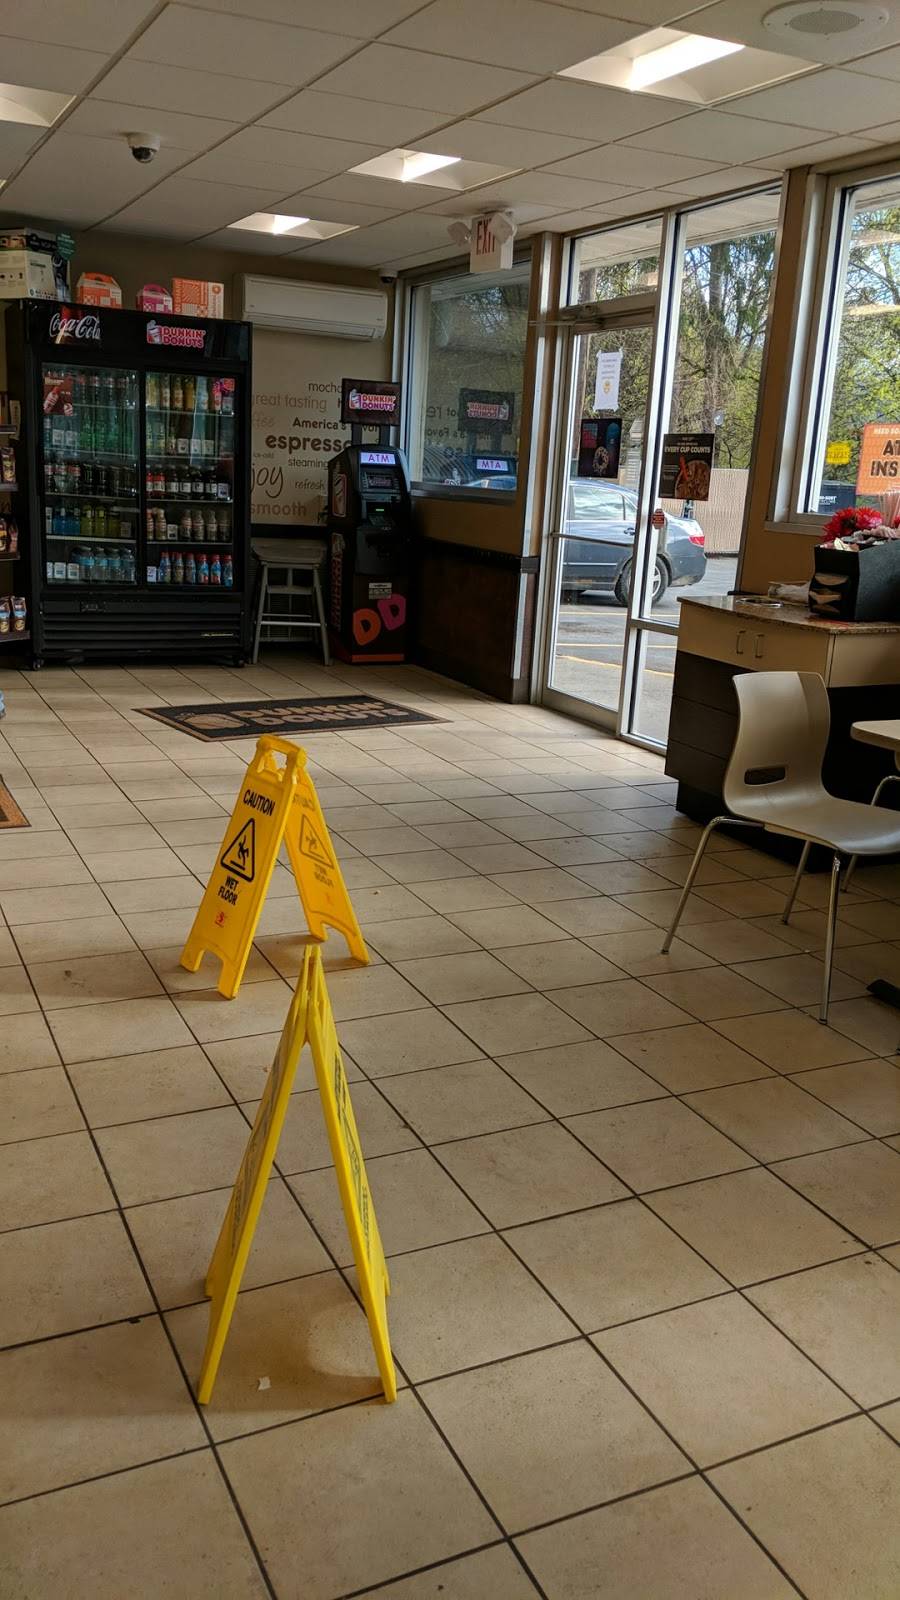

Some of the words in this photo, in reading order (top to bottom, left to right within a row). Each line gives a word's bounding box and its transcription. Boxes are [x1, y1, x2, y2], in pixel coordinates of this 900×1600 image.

[49, 312, 101, 340] Coca-Cola
[163, 326, 206, 338] DUNKIN'
[163, 336, 203, 347] DONUTS
[252, 394, 281, 407] reat
[285, 396, 327, 413] tasting
[362, 402, 394, 411] DONUTS
[288, 457, 329, 471] steaming
[367, 454, 390, 463] ATM
[250, 502, 307, 516] smooth
[251, 708, 409, 727] DONUTS
[243, 789, 276, 817] CAUTION
[225, 875, 240, 892] WET
[217, 887, 239, 906] FLOOR
